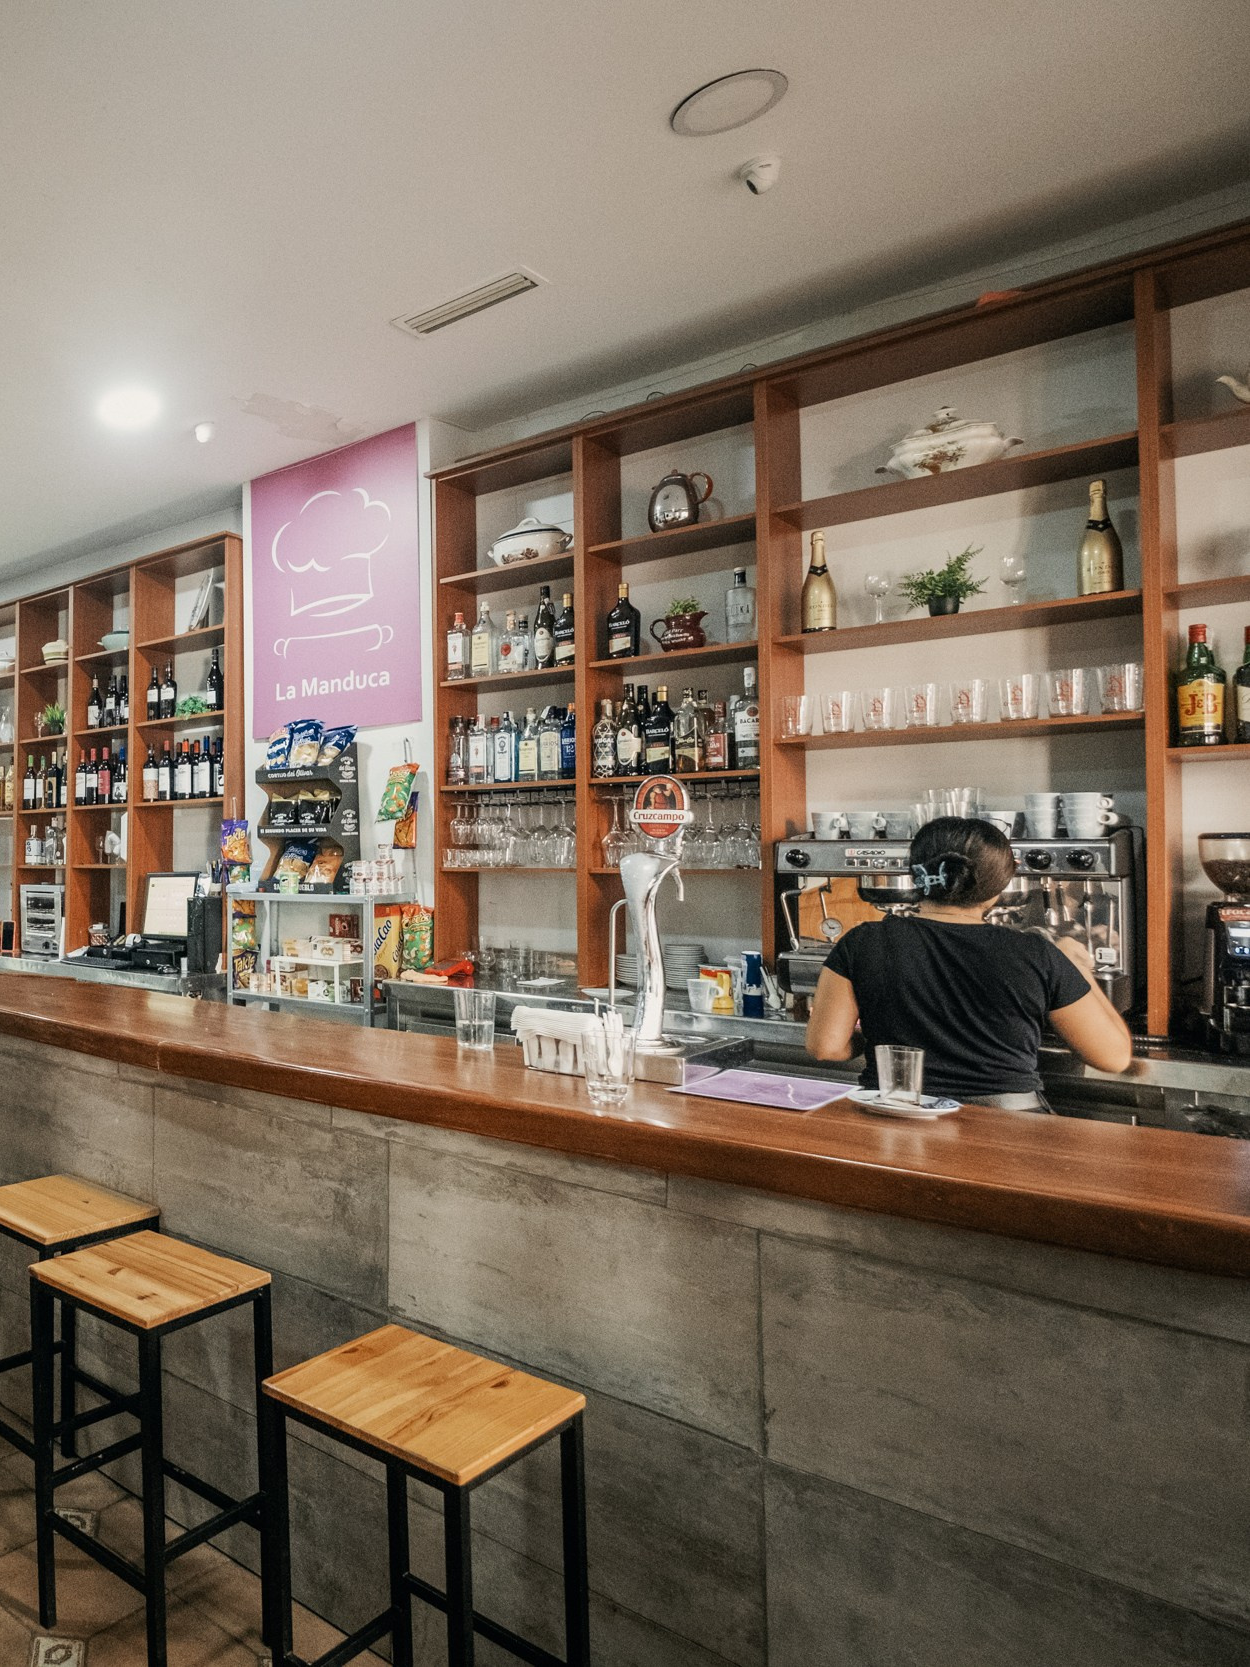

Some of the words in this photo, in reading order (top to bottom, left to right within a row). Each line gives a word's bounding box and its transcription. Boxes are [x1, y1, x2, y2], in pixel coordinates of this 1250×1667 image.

[275, 683, 297, 702] La
[301, 669, 391, 698] Manduca
[739, 717, 759, 725] BACAR
[633, 811, 685, 822] Cruzcampo
[298, 884, 314, 892] UEBLO
